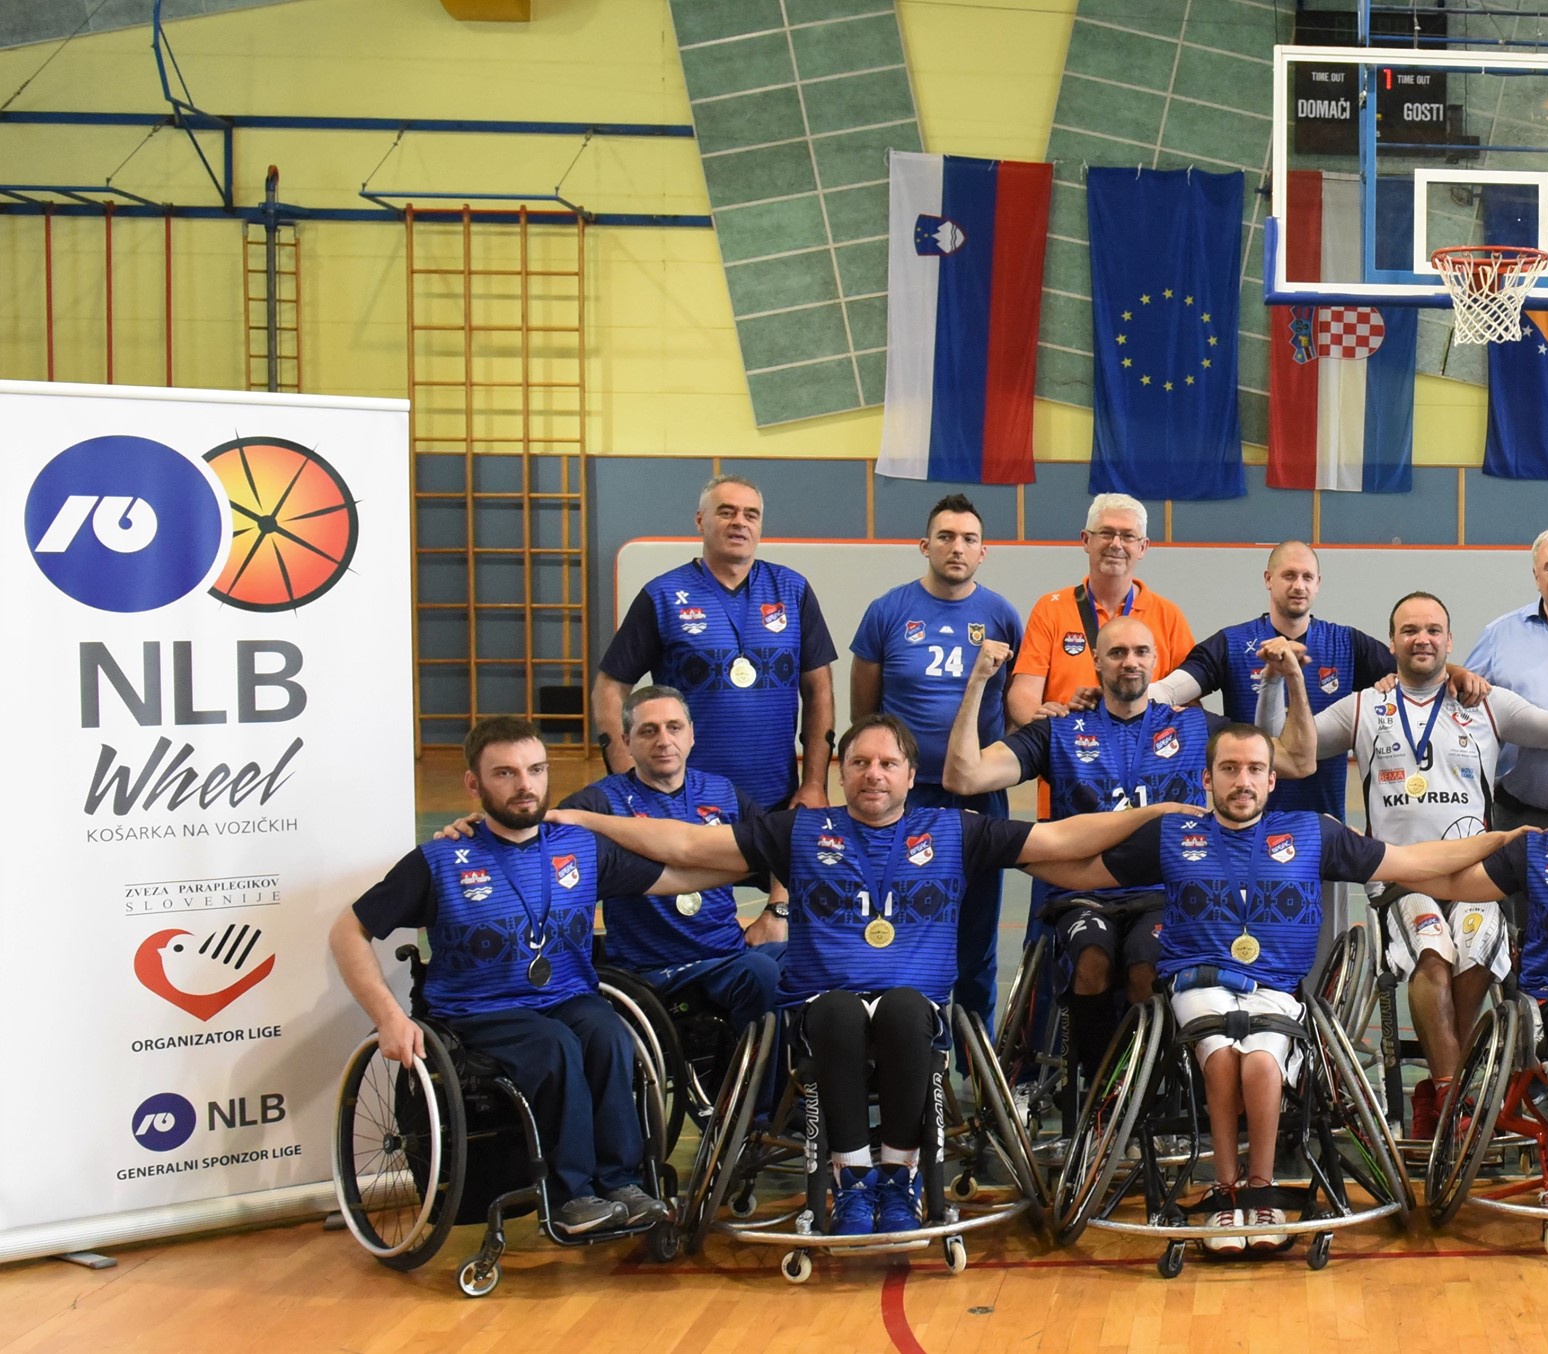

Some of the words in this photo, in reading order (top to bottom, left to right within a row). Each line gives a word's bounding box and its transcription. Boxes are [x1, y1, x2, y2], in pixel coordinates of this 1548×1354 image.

[1312, 72, 1329, 82] TIME
[1330, 72, 1345, 82] OUT
[1397, 75, 1414, 84] TIME
[1416, 76, 1431, 85] OUT
[1298, 97, 1350, 120] DOMAČI
[1404, 102, 1444, 122] GOSTI
[926, 646, 964, 677] 24
[79, 639, 308, 728] NLB
[1416, 740, 1434, 772] 9
[84, 735, 304, 816] Wheel
[1112, 785, 1148, 812] 21
[1417, 792, 1468, 804] VRBAS
[87, 824, 176, 843] KOŠARKA
[183, 823, 210, 838] NA
[215, 816, 298, 835] VOZIČKIH
[125, 886, 169, 898] ZVEZA
[178, 878, 280, 894] PARAPLEGIKOV
[1068, 917, 1107, 941] 21
[1462, 912, 1484, 948] 9
[132, 1029, 244, 1052] ORGANIZATOR
[248, 1025, 282, 1040] LIGE
[208, 1092, 286, 1132] NLB
[116, 1159, 198, 1180] GENERALNI
[202, 1150, 269, 1168] SPONZOR
[272, 1144, 302, 1158] LIGE
